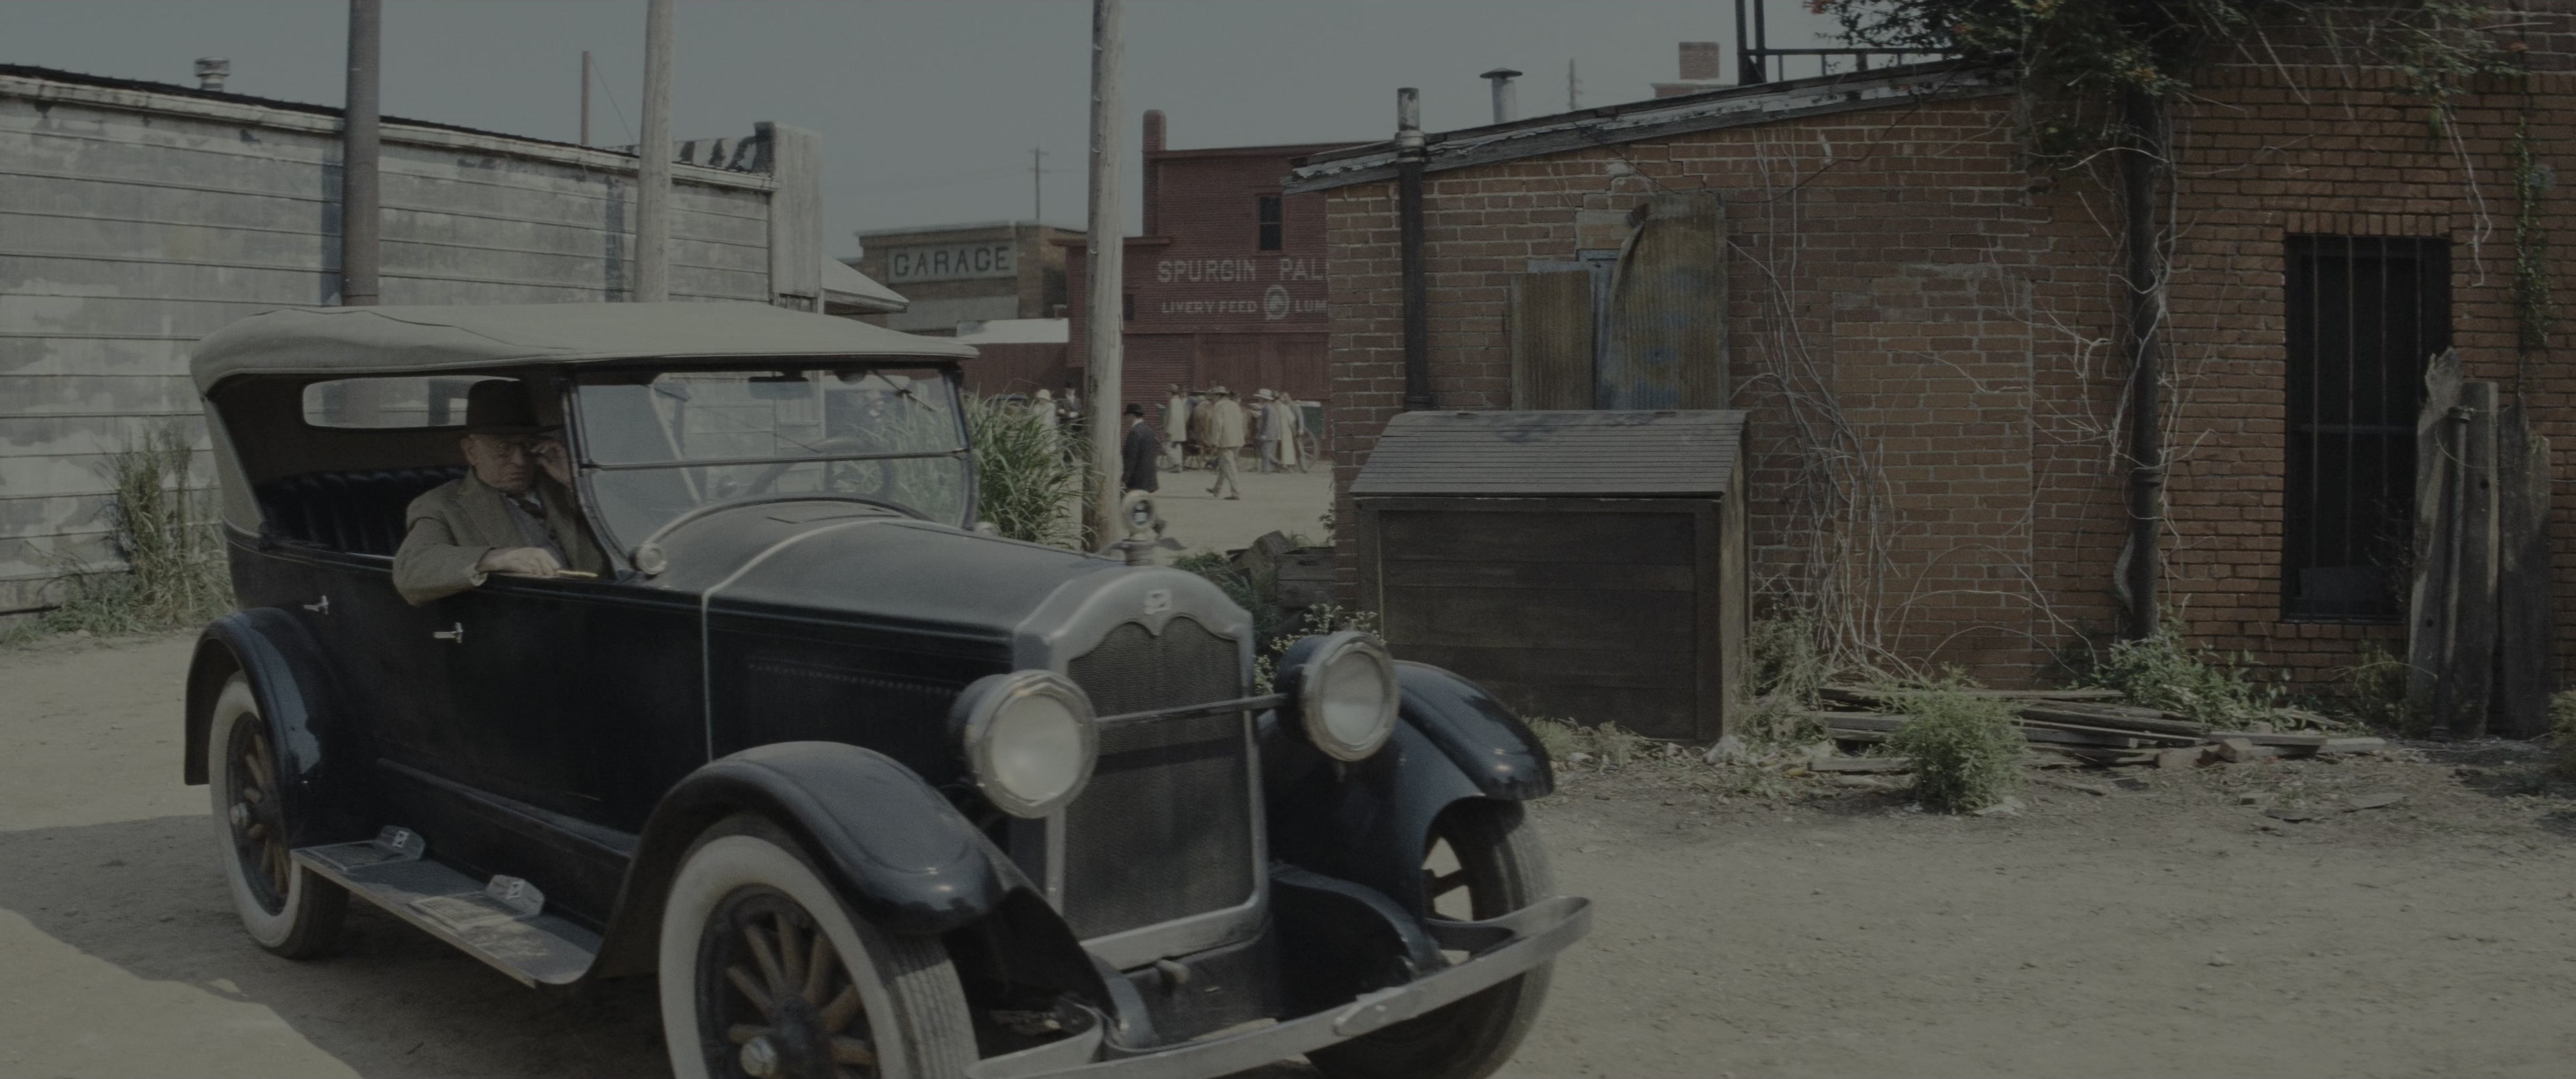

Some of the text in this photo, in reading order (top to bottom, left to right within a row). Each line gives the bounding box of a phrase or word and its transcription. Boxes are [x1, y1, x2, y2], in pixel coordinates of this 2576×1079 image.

[894, 246, 1010, 276] GARAGE
[1157, 258, 1330, 282] SPURGIN PAL
[1161, 301, 1213, 313] LIVERY
[1218, 301, 1257, 313] FEED
